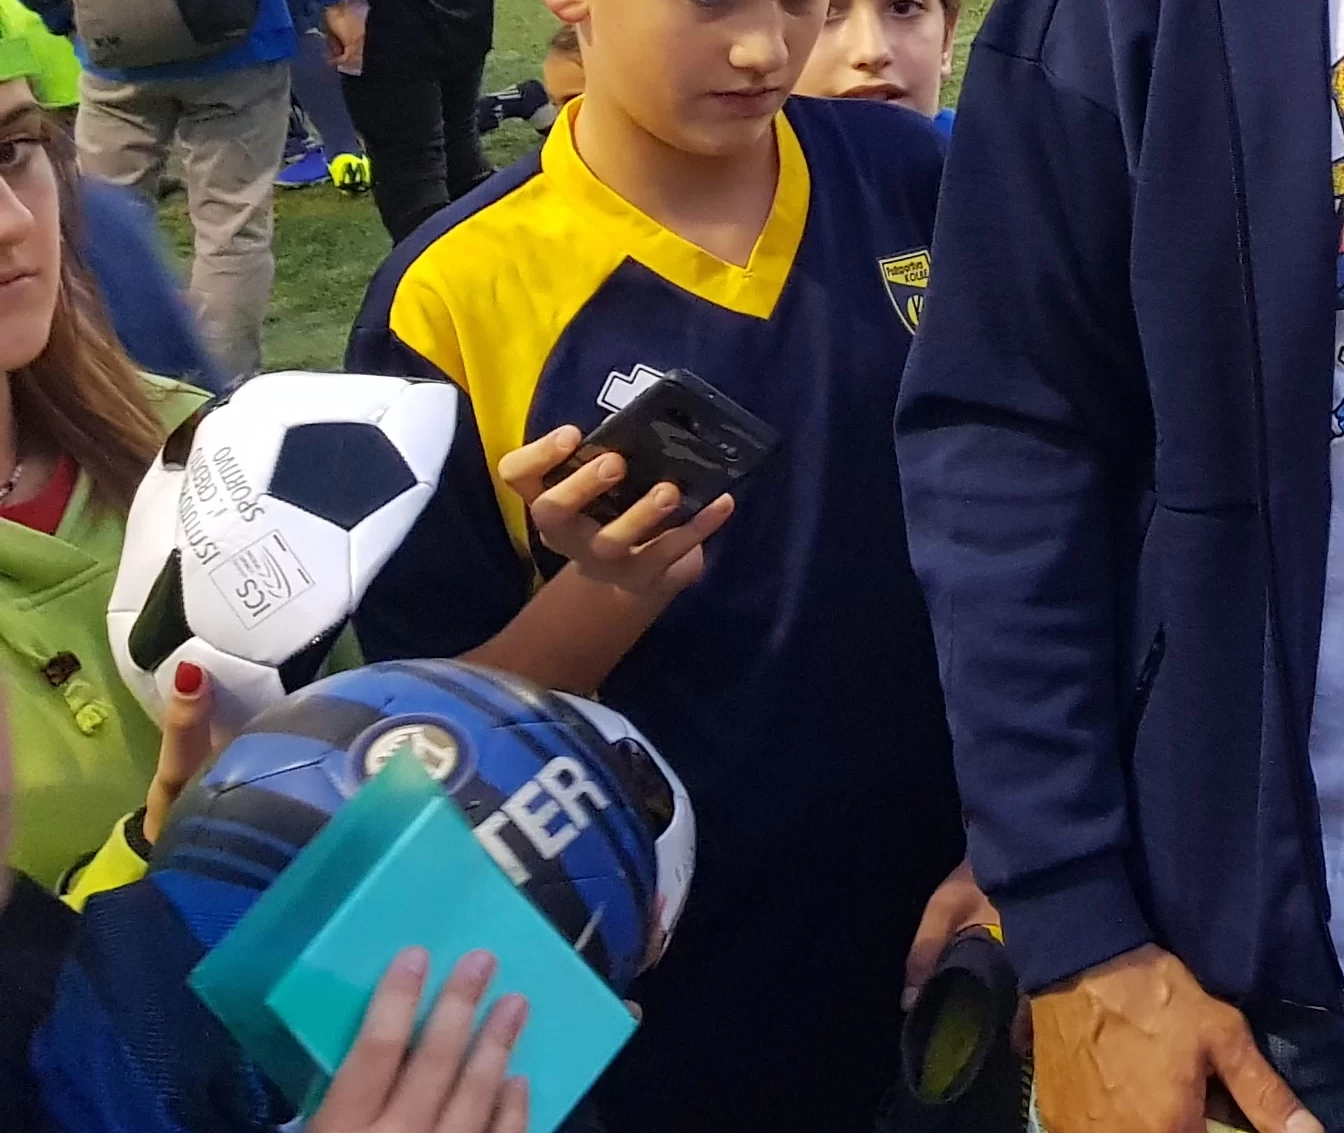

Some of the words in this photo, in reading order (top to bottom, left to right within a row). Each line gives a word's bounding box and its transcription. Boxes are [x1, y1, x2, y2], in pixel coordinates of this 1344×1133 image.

[213, 447, 265, 523] SPORTIVO
[235, 578, 271, 618] ICS
[473, 756, 610, 886] TER
